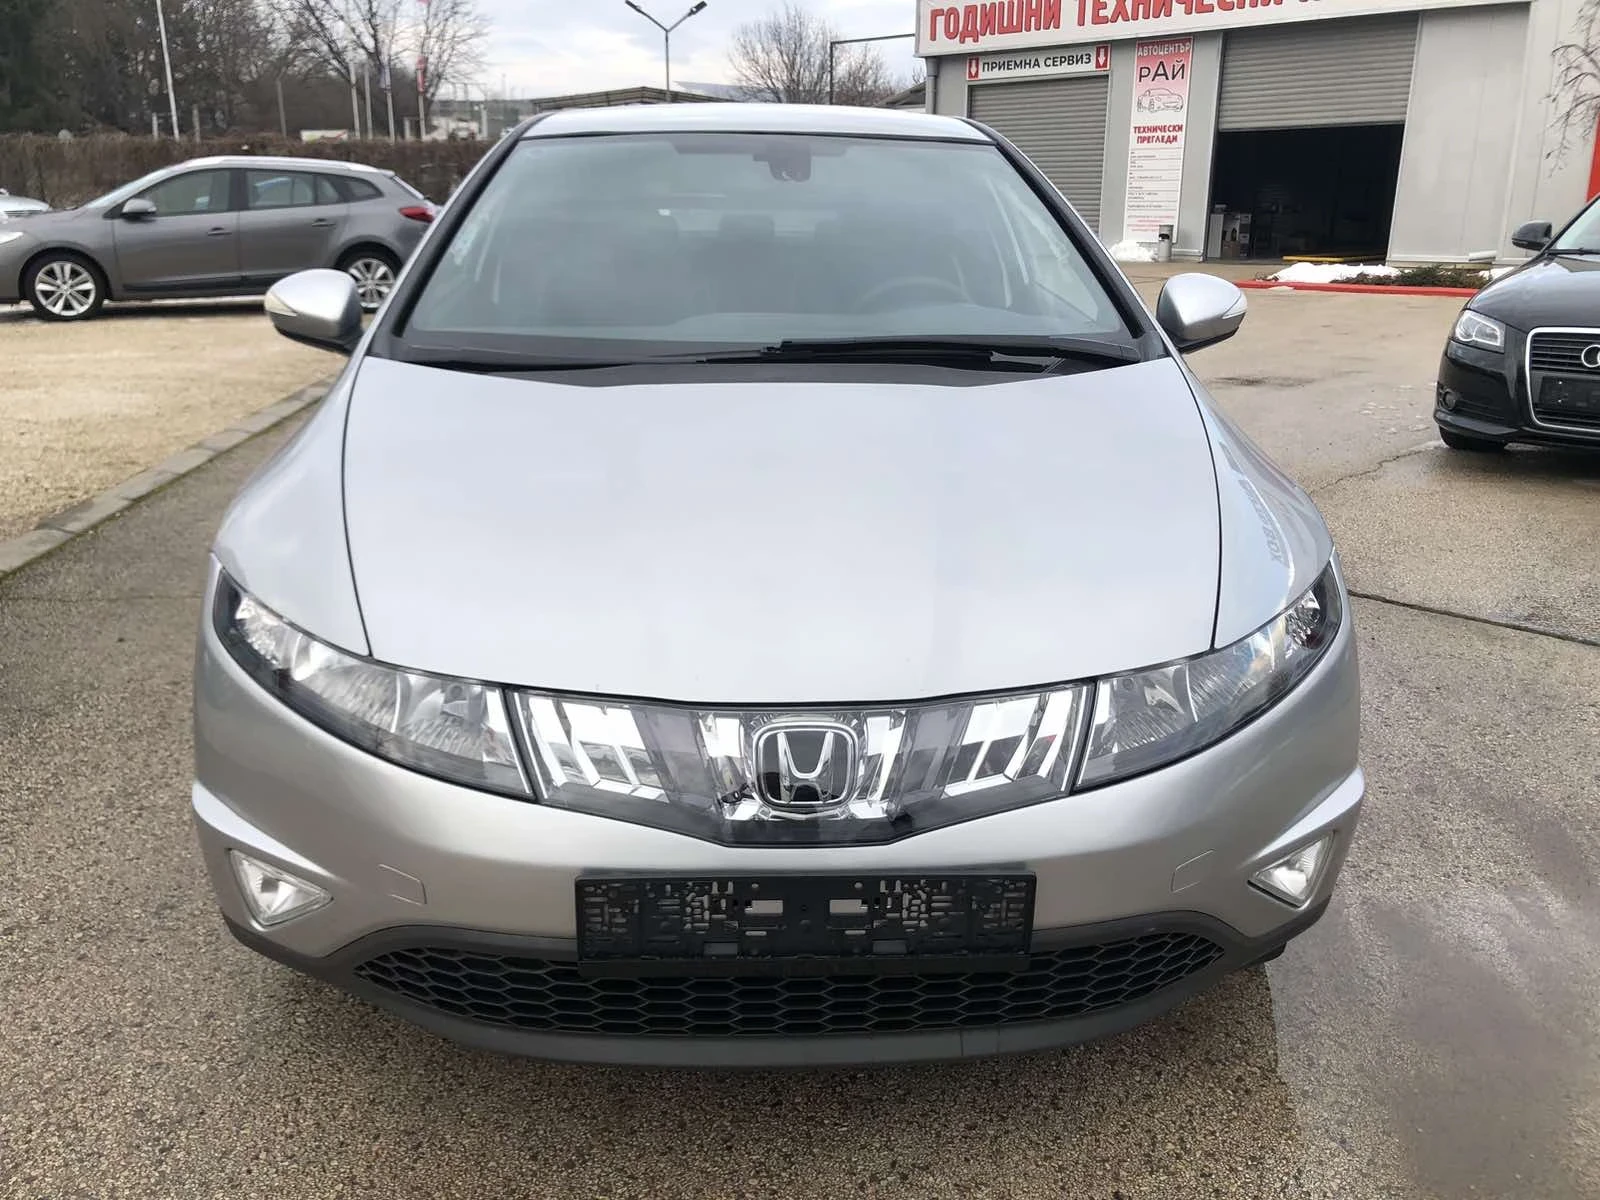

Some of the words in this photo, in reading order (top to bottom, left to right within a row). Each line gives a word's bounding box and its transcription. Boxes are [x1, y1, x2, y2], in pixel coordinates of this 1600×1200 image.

[930, 0, 1062, 43] ГОДИШНИ
[1076, 0, 1283, 26] ТЕХНИ
[1138, 42, 1191, 57] АВТОЦЕНТЪР
[982, 58, 1041, 73] ПРИЕМНА
[1044, 53, 1092, 68] СЕРВИЗ
[1138, 59, 1185, 83] РАЙ
[1133, 124, 1184, 135] ТЕХНИЧЕСКИ
[1136, 135, 1178, 145] ПРЕГЛЕДИ
